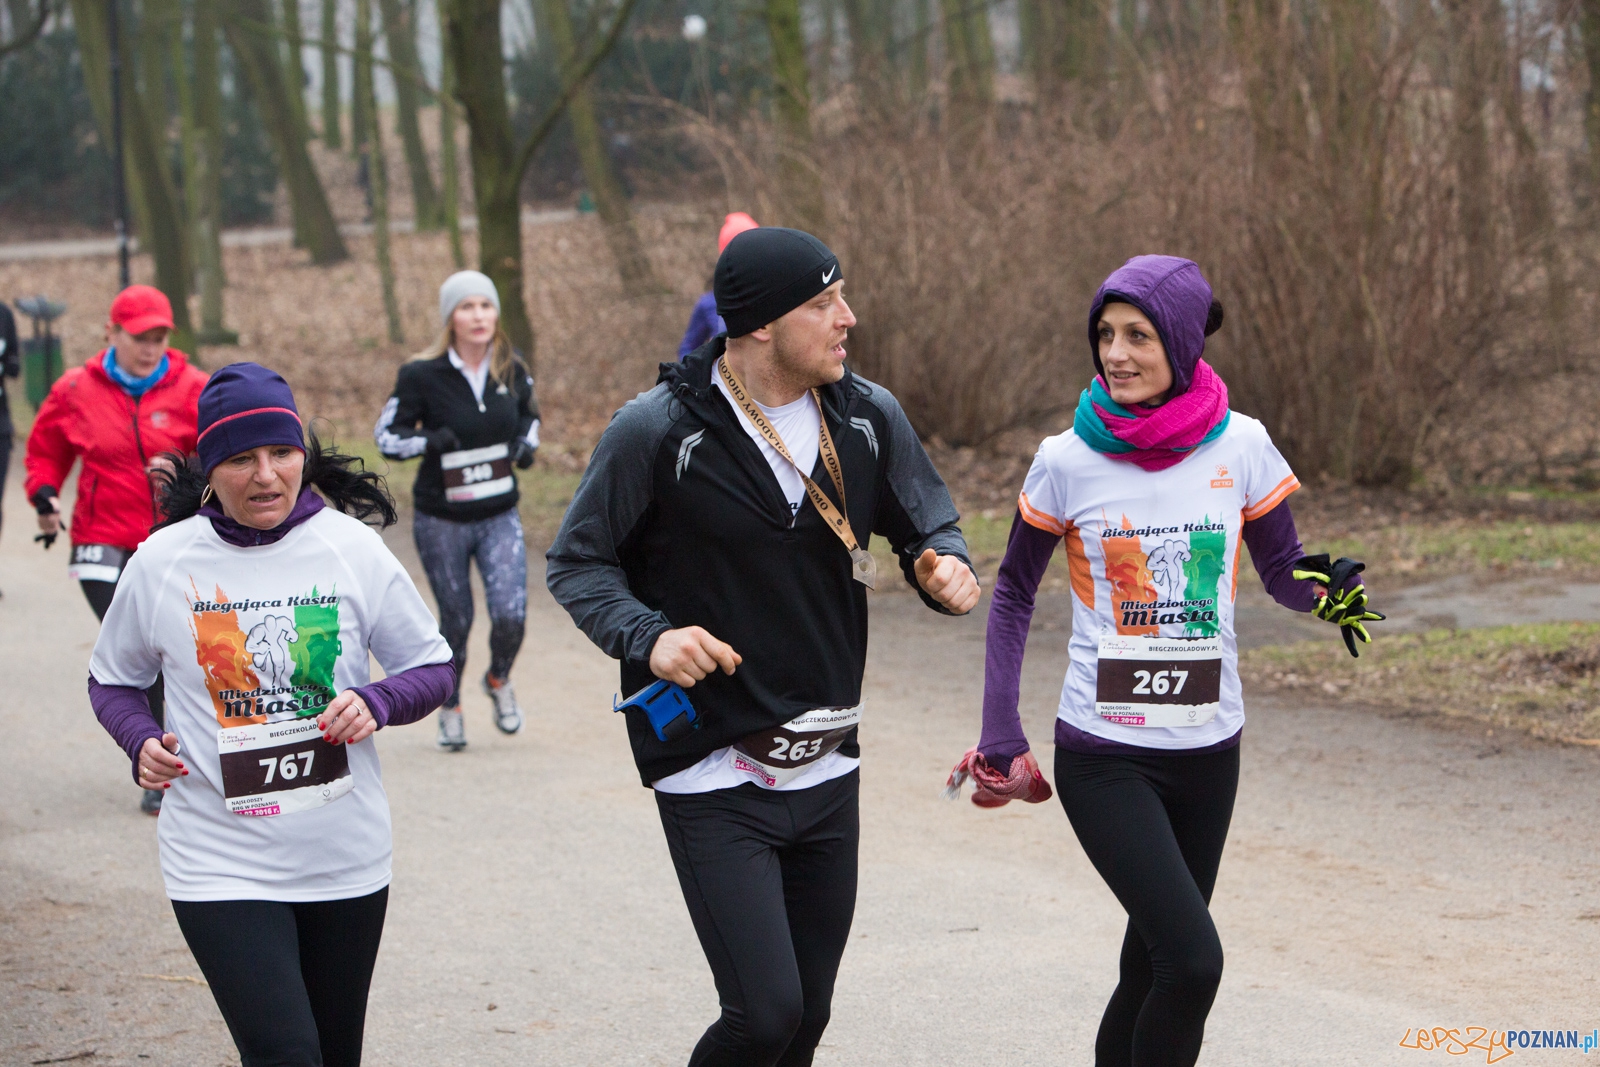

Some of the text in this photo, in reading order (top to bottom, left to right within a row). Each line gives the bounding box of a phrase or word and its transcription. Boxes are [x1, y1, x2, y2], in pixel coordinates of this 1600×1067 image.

[1102, 523, 1225, 538] Biegająca Kasta
[193, 595, 337, 613] Biegająca Kasta
[1120, 598, 1213, 610] Miedziowego
[1122, 609, 1216, 626] Miasta
[1132, 670, 1188, 695] 267
[219, 685, 331, 700] Miedziowego
[224, 693, 331, 717] Miasta
[768, 737, 823, 761] 263
[259, 750, 315, 784] 767
